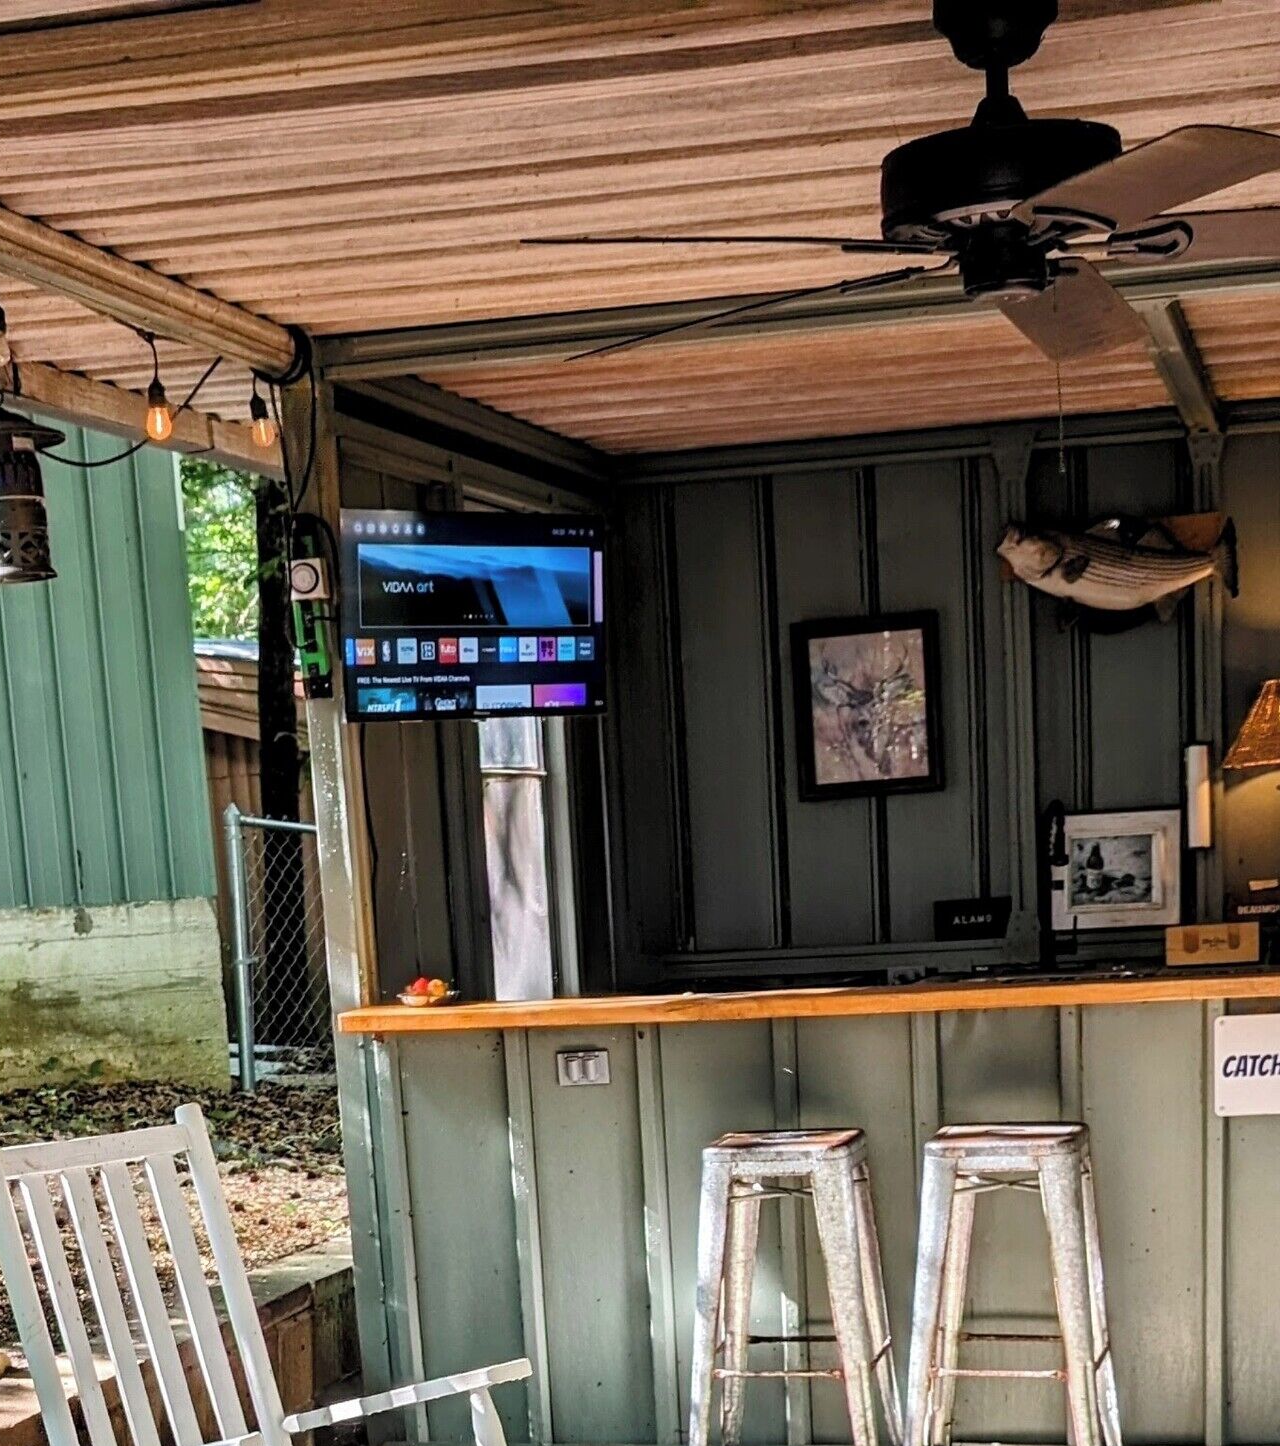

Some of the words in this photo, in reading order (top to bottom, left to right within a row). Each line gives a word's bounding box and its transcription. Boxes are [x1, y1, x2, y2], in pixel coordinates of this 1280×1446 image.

[382, 581, 414, 593] VIDAA
[416, 580, 434, 593] art
[952, 914, 992, 925] ALAMO
